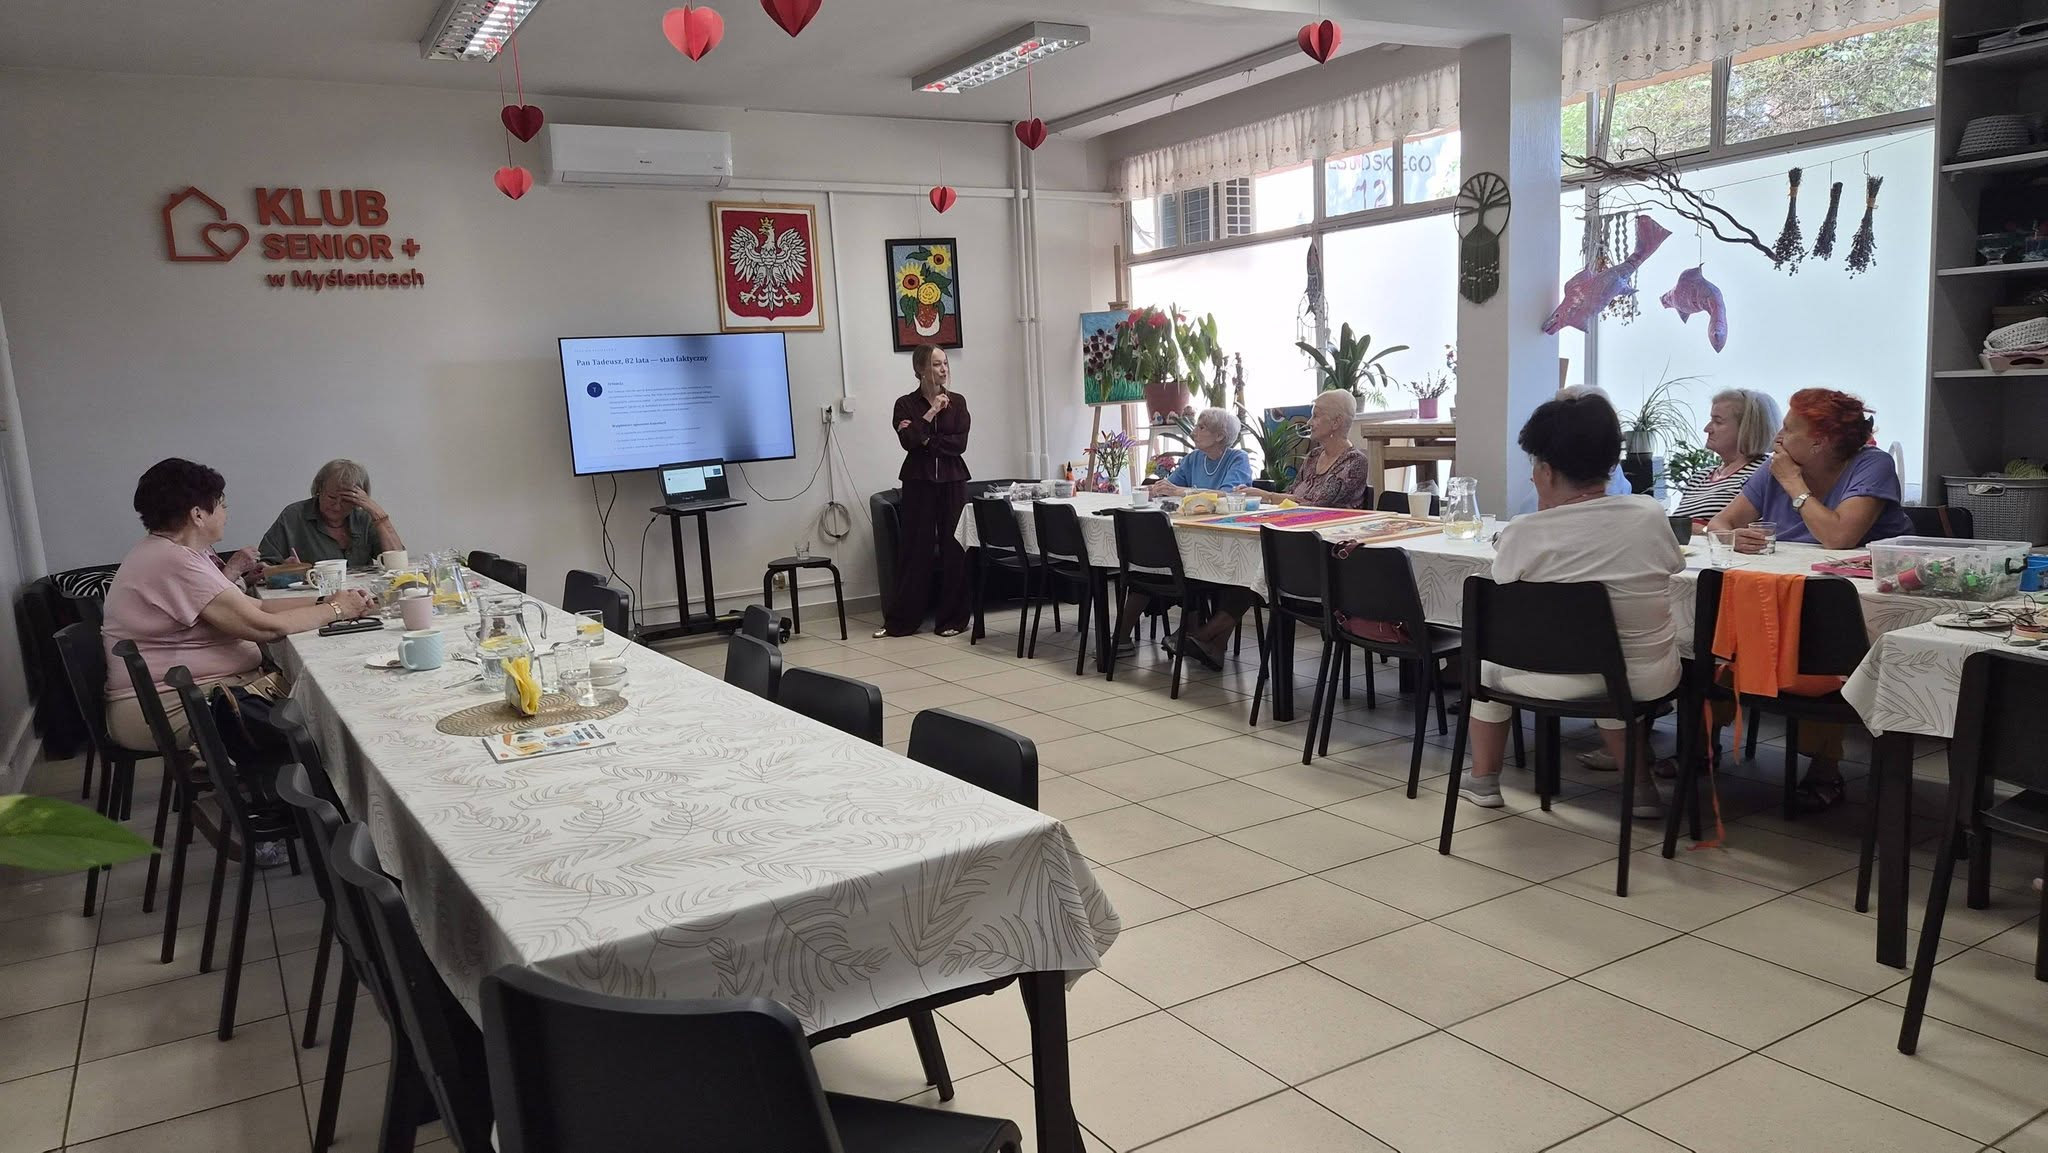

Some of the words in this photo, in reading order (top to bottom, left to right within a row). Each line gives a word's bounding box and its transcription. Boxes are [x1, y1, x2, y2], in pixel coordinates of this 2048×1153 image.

[255, 187, 389, 226] KLUB
[1353, 179, 1386, 208] 12
[263, 233, 394, 260] SENIOR
[401, 238, 421, 258] +
[267, 273, 285, 287] w
[292, 268, 425, 292] Myślenicach
[576, 358, 591, 367] Pan
[592, 357, 624, 367] Tadeusz,
[635, 356, 650, 364] lata
[660, 355, 675, 364] stan
[675, 354, 709, 364] faktyczny
